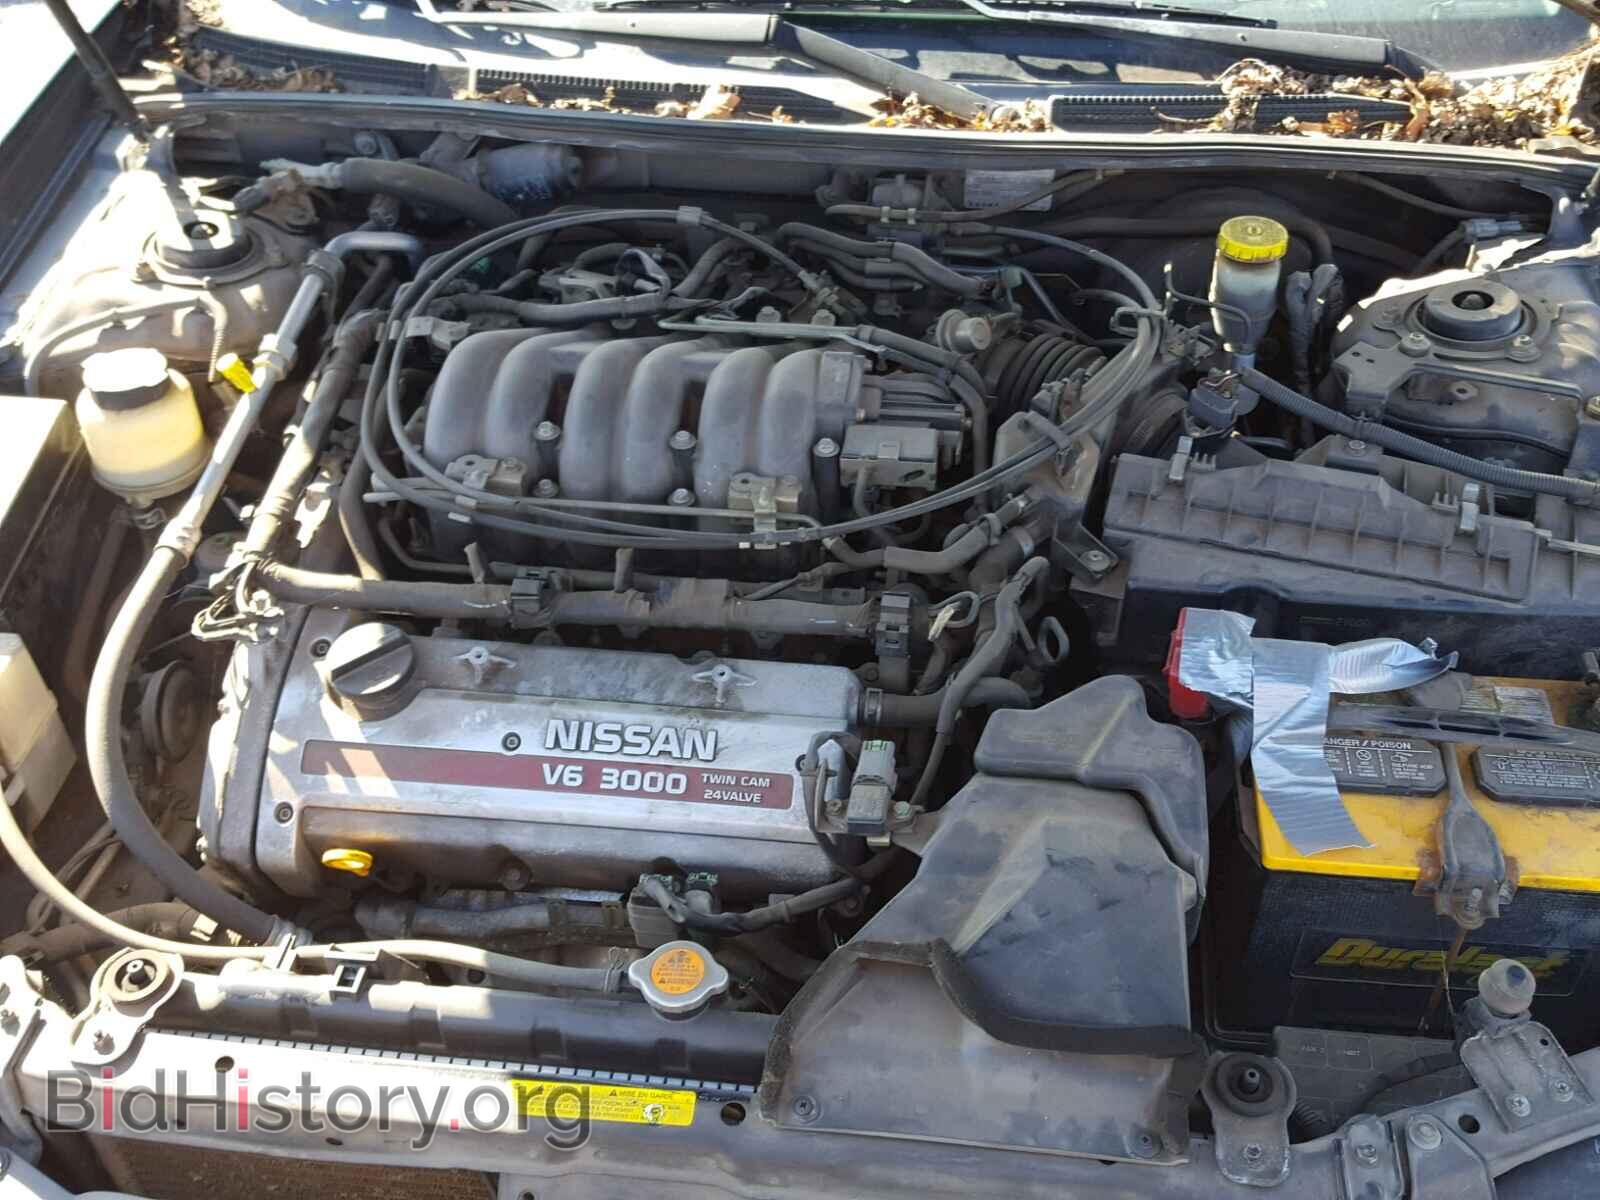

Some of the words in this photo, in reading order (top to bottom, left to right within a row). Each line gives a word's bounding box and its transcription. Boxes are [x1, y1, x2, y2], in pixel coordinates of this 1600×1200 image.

[544, 719, 718, 761] NISSAN
[1322, 738, 1360, 747] ANGER
[1371, 739, 1411, 750] POISON
[541, 763, 584, 788] V6
[599, 767, 687, 794] 3000
[701, 772, 736, 786] TWIN
[740, 775, 770, 788] CAM
[703, 788, 762, 804] 24VALVE
[1315, 938, 1567, 975] Duralat
